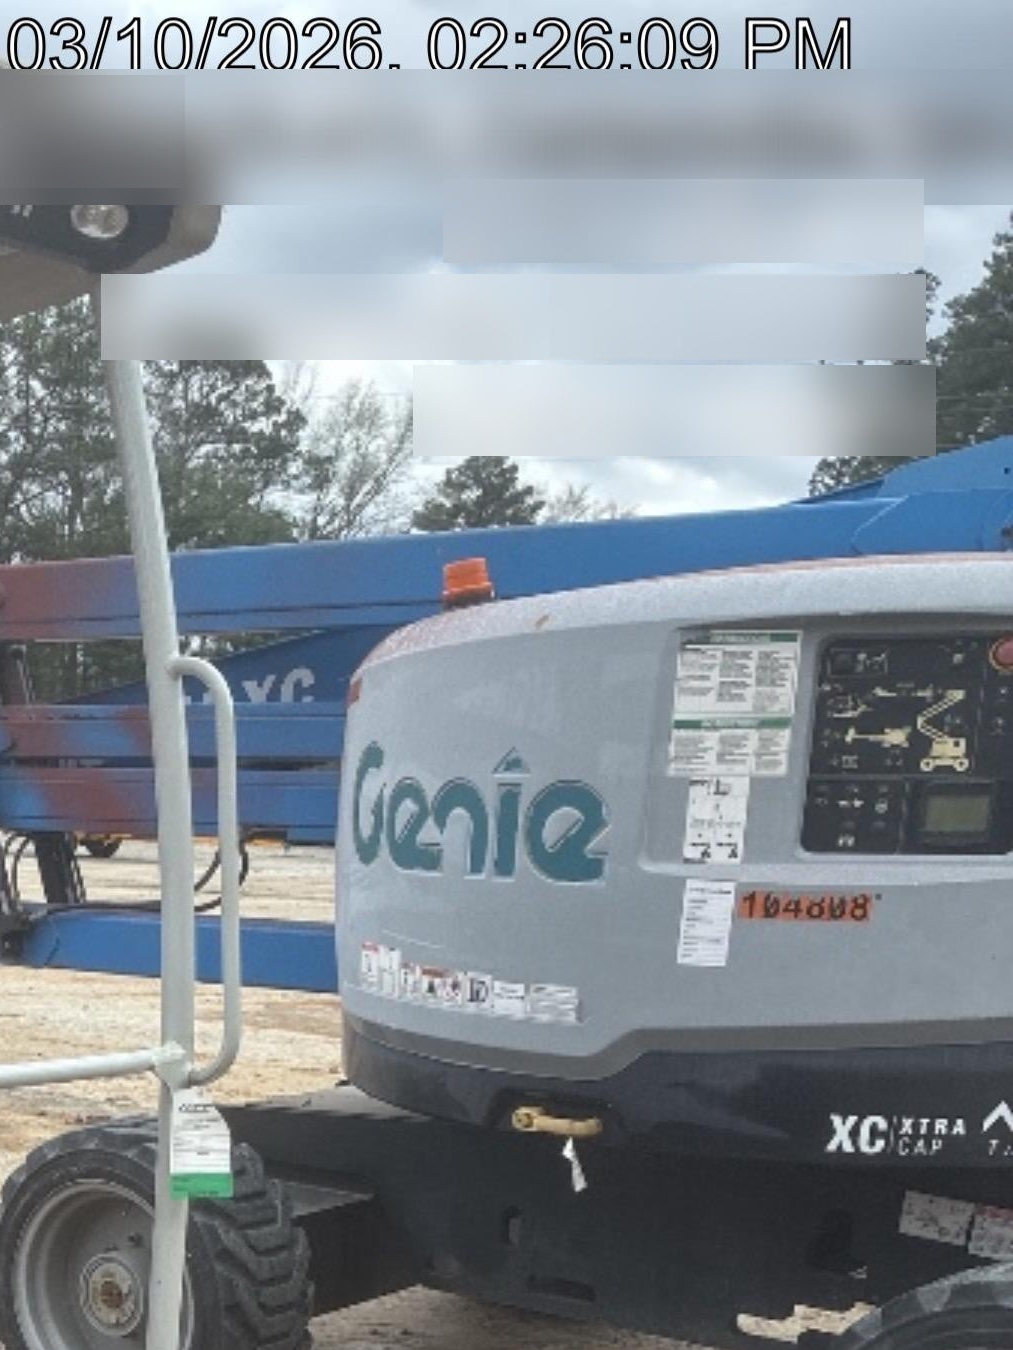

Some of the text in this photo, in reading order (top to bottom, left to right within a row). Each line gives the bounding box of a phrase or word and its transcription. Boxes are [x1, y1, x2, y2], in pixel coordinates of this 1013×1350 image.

[352, 740, 610, 884] Genie
[825, 1114, 967, 1153] XC XTRA
[898, 1137, 944, 1156] CAP
